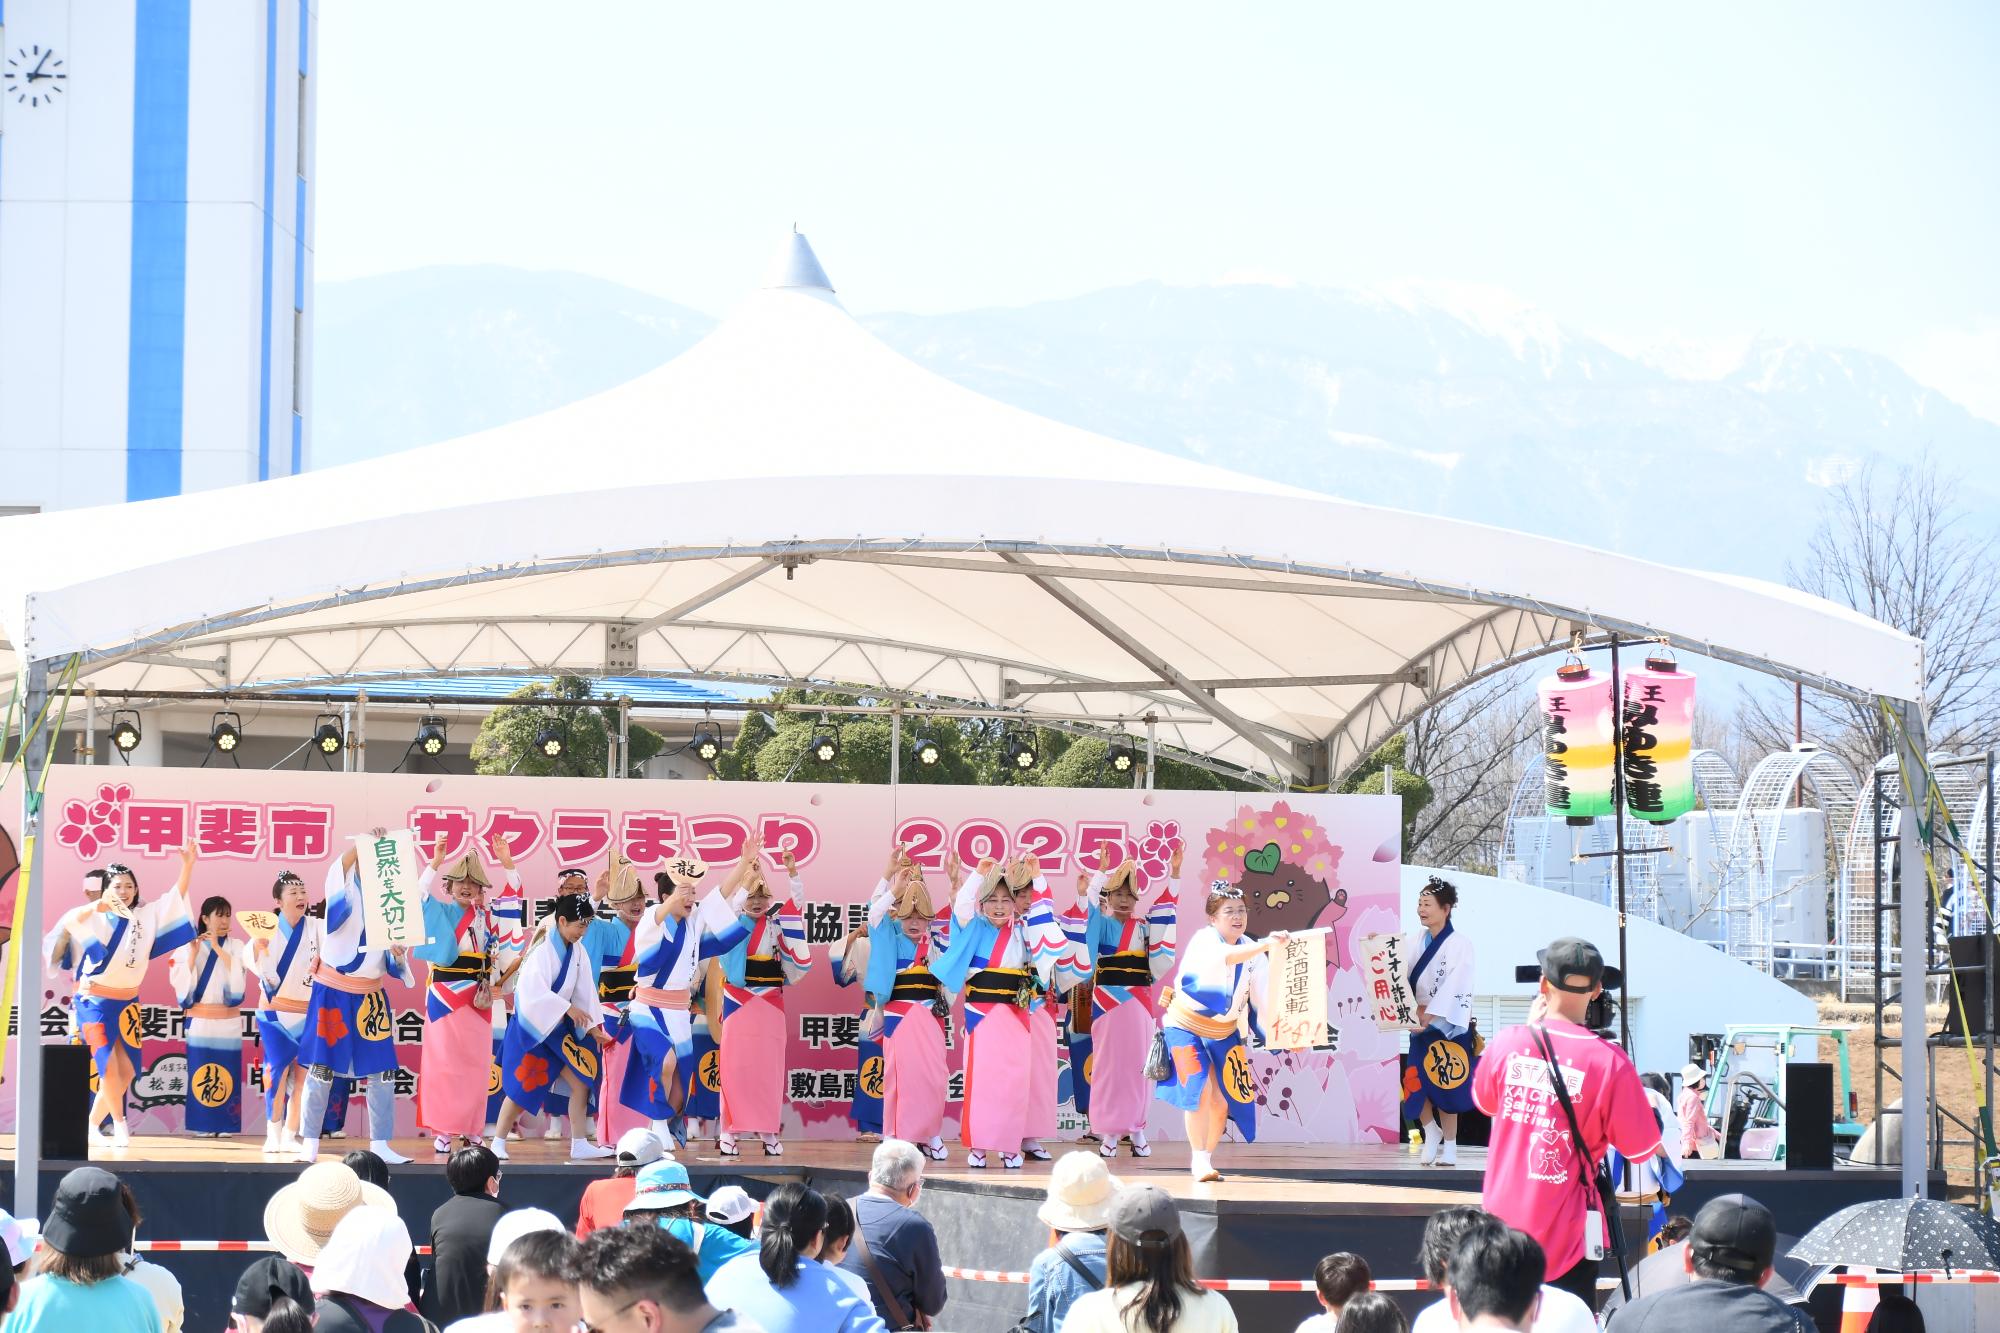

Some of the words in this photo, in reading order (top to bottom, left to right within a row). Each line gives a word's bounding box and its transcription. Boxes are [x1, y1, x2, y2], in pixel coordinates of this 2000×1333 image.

[126, 804, 330, 858] 甲斐市
[411, 809, 816, 867] サクラまつり
[896, 819, 1127, 873] 2025
[374, 836, 405, 941] 自然を大切に
[1284, 937, 1309, 1015] 飲酒運転
[1371, 951, 1397, 1022] ご用心
[1386, 937, 1416, 1025] オレオレ詐欺
